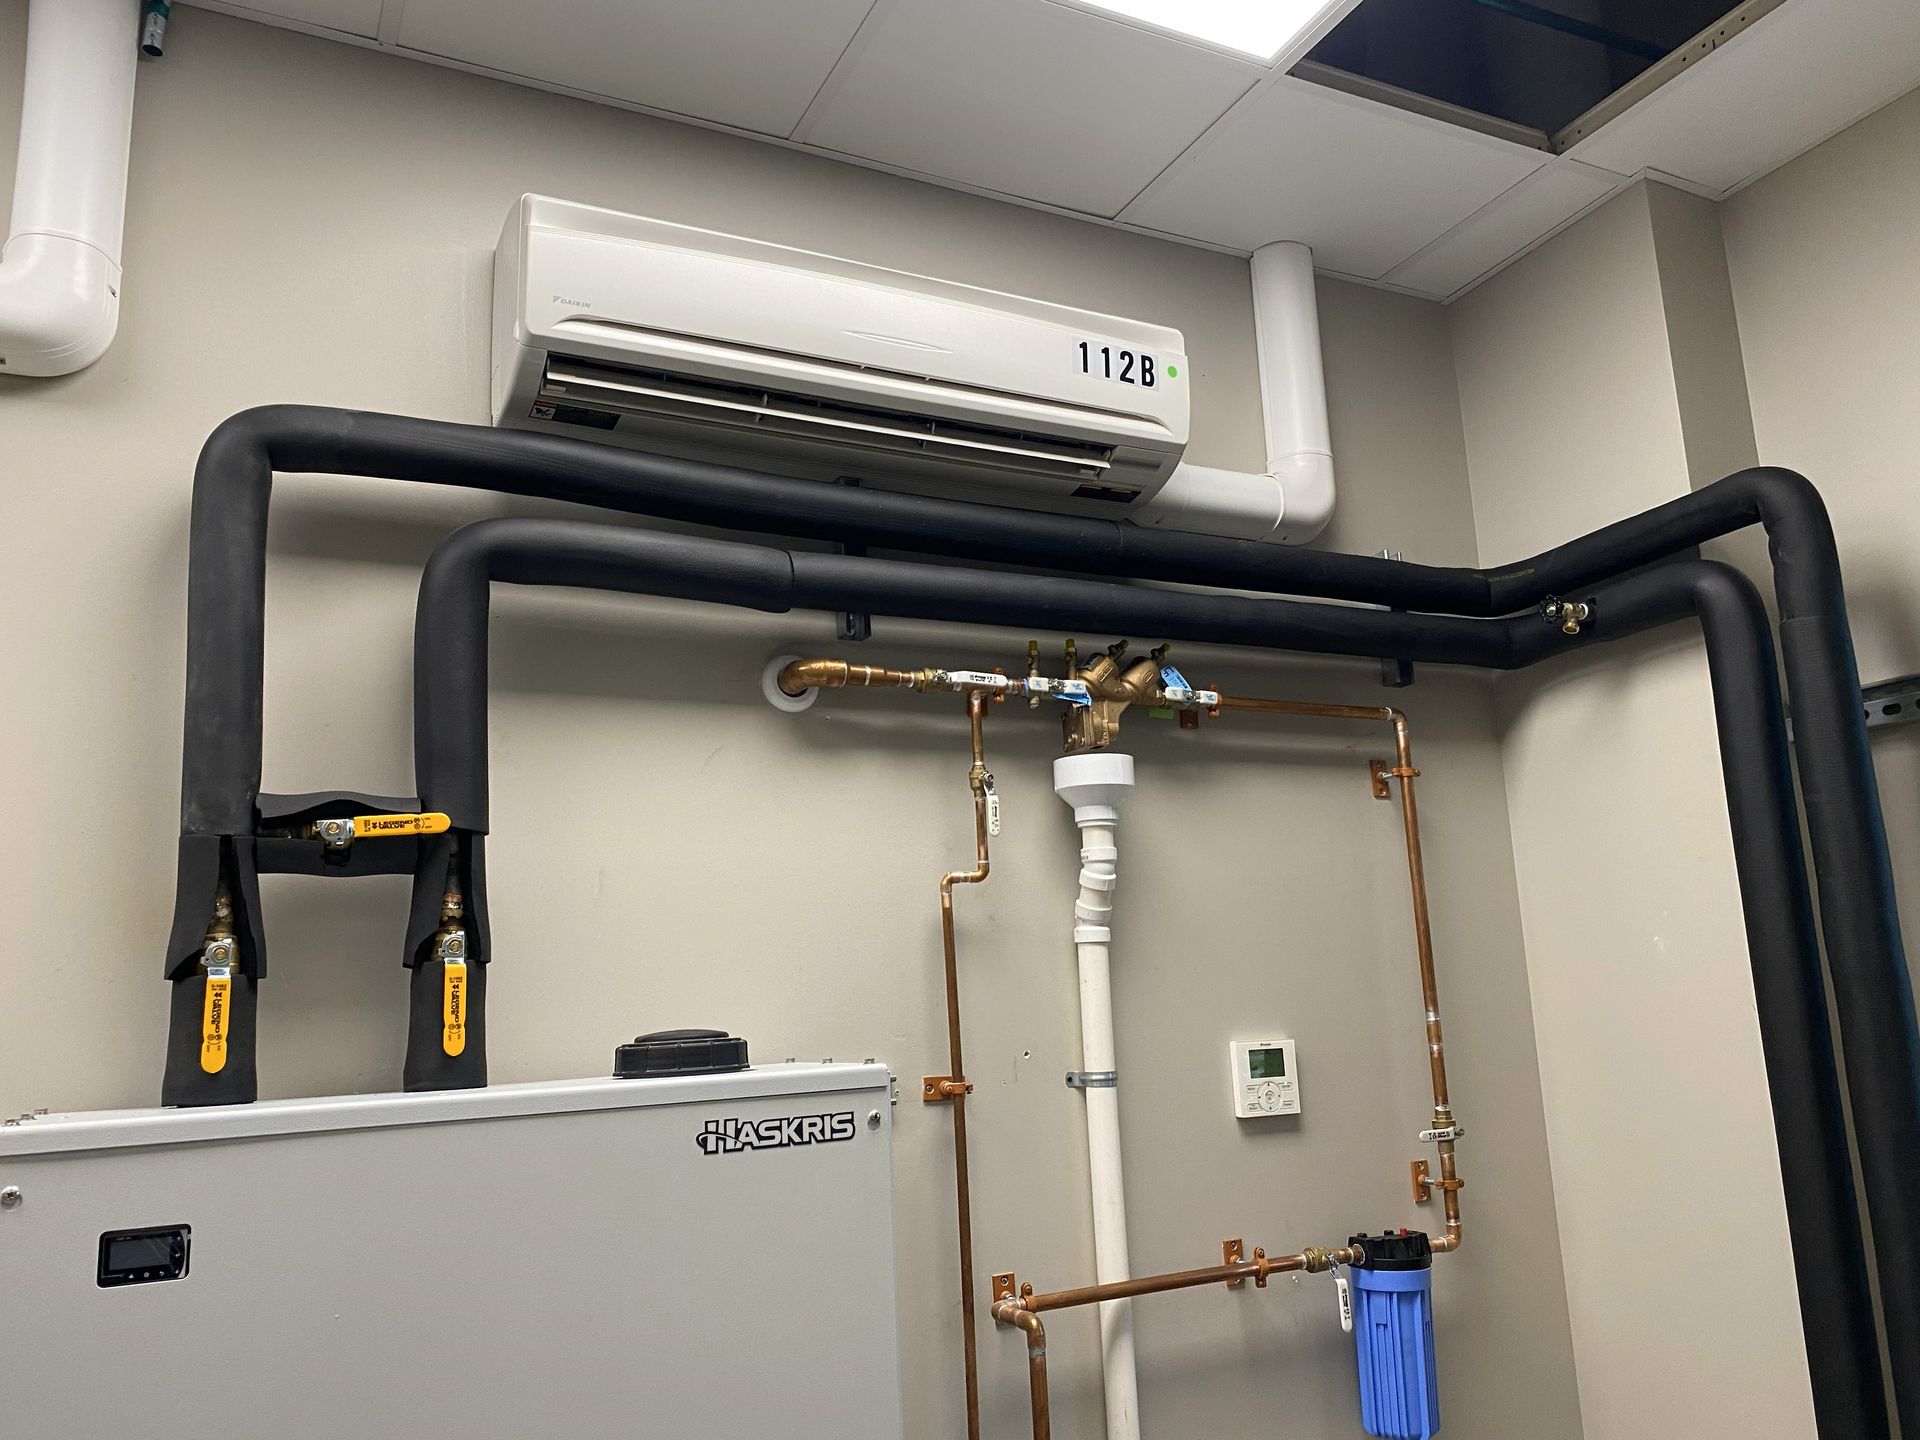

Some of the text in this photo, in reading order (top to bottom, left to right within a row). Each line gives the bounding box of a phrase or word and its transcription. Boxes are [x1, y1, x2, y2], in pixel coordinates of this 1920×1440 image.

[560, 298, 591, 308] DAIKIN
[1079, 341, 1155, 387] 112B
[696, 1111, 857, 1155] HASKRIS
